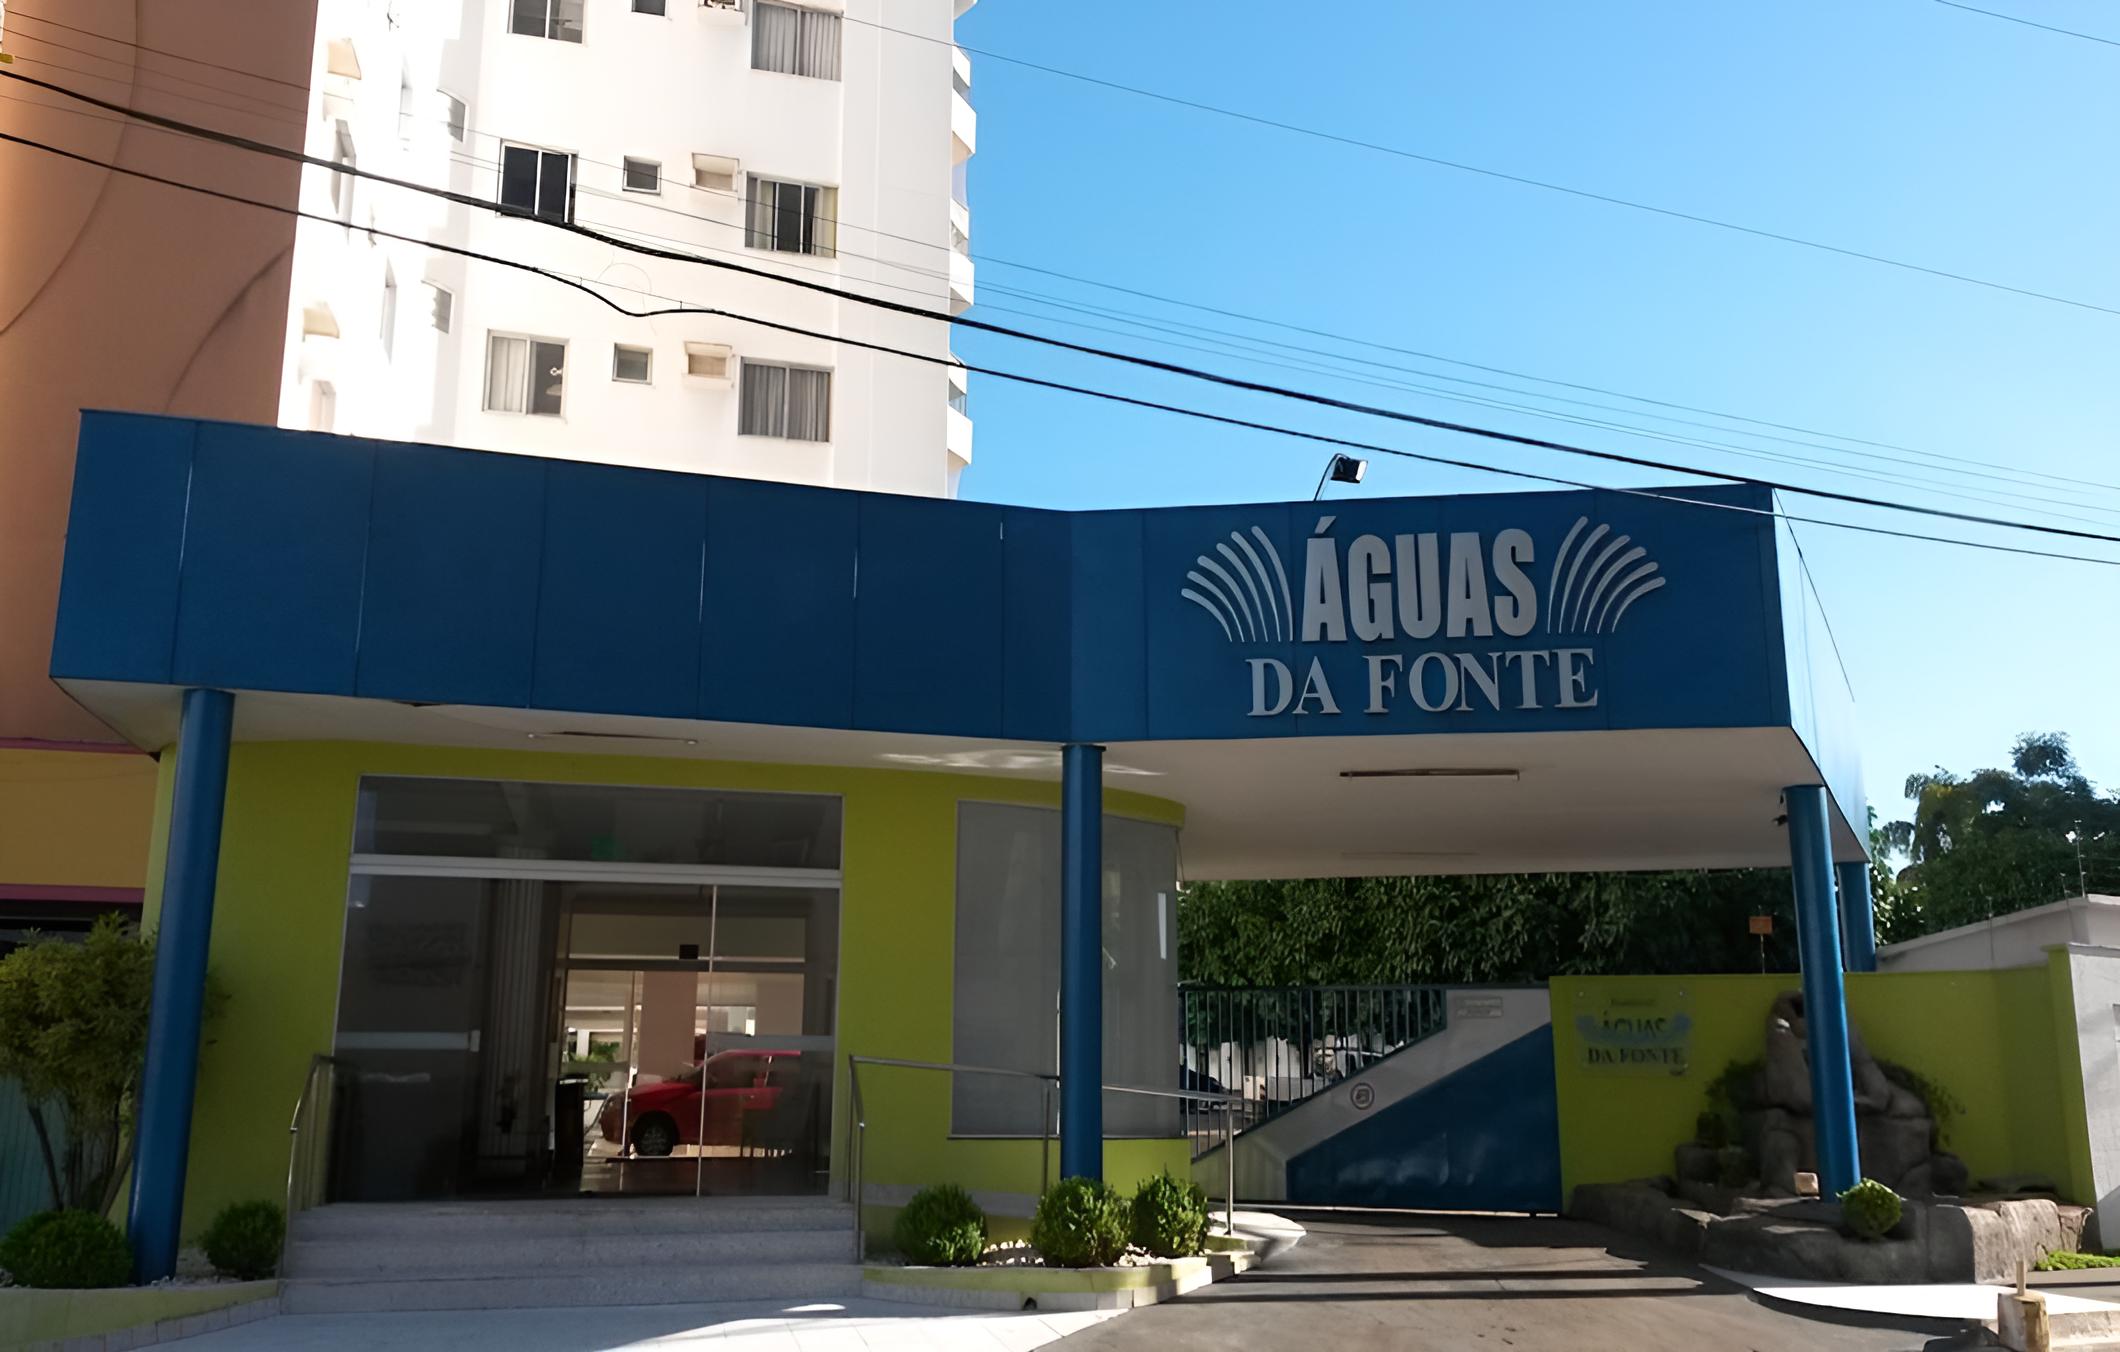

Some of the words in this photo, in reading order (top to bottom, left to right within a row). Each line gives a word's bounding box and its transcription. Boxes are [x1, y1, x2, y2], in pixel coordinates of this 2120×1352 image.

[1302, 515, 1538, 642] ÁGUAS
[1245, 655, 1341, 717] DA
[1362, 647, 1598, 714] FONTE
